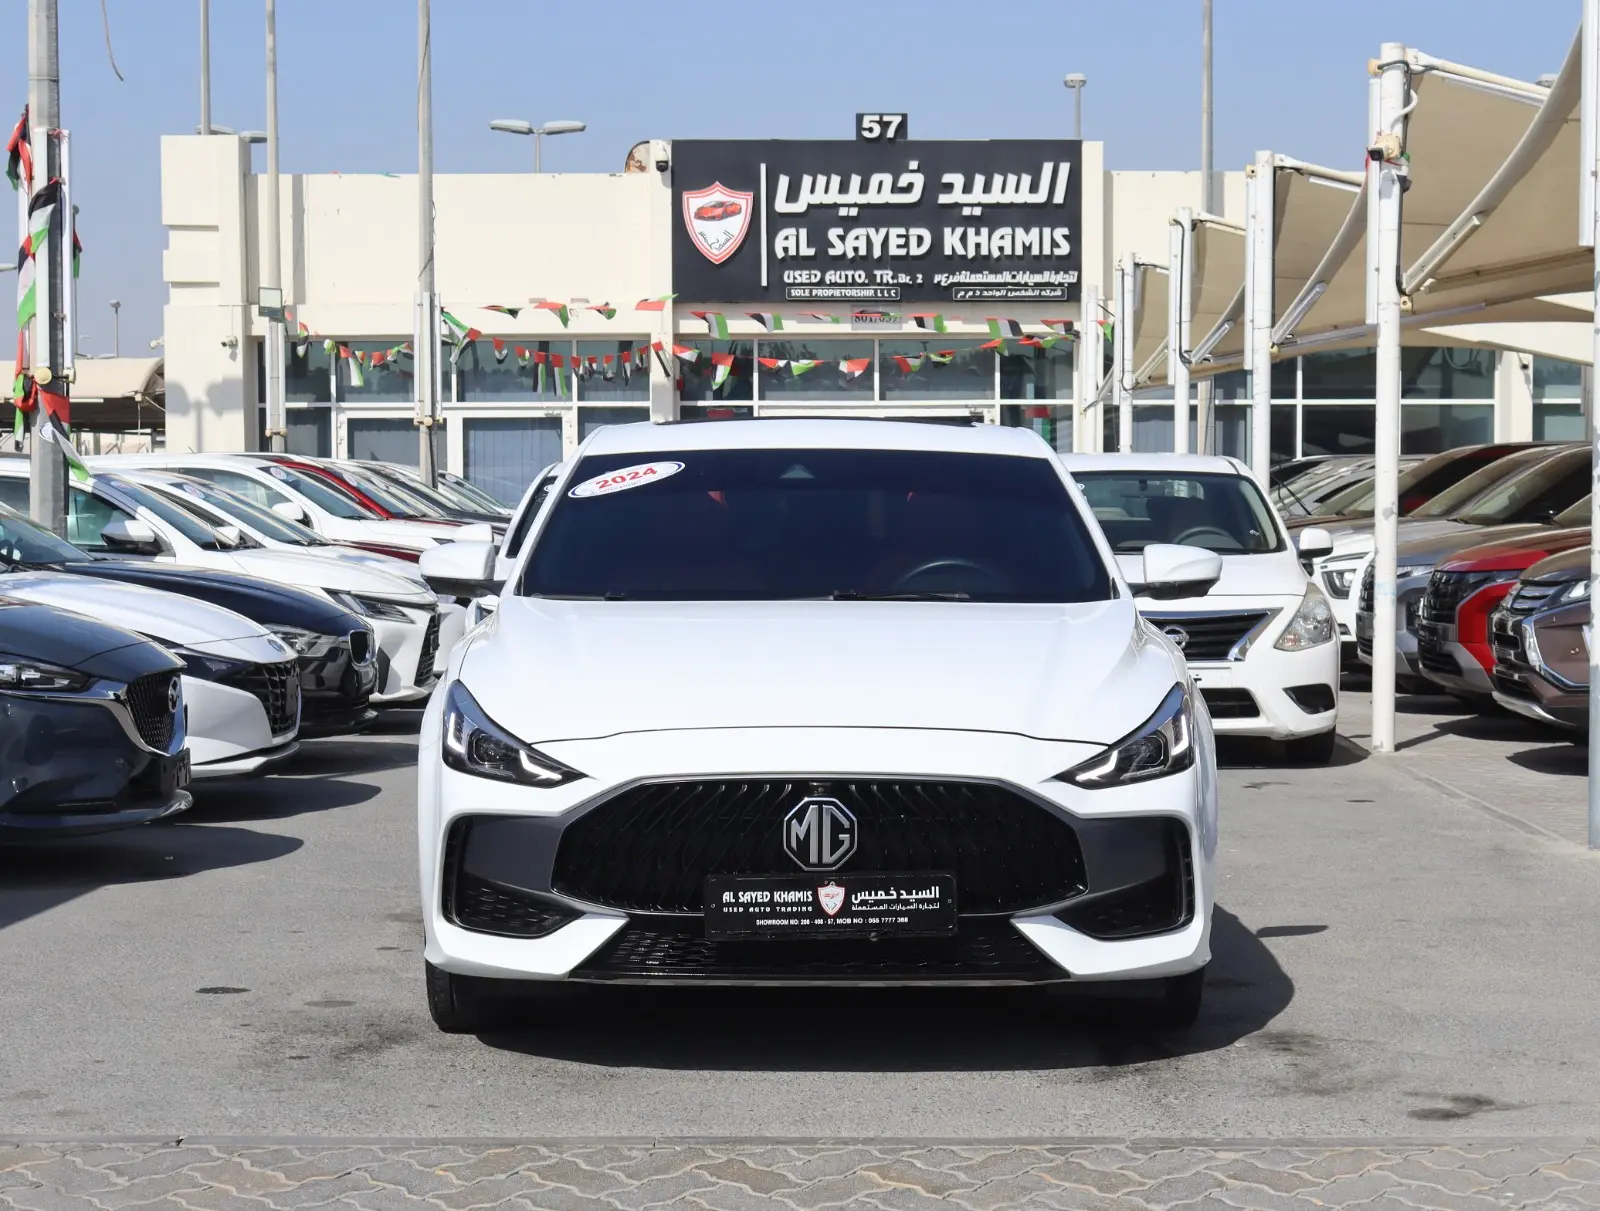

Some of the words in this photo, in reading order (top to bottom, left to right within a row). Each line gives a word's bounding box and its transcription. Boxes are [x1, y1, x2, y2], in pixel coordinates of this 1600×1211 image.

[860, 115, 903, 139] 57
[774, 160, 925, 216] خميس
[937, 162, 1071, 216] السيد
[774, 227, 816, 260] AL
[827, 227, 932, 260] SAYED
[943, 227, 1071, 260] KHAMIS
[783, 269, 821, 284] USED
[916, 273, 924, 284] 2
[790, 288, 810, 297] SOLE
[982, 288, 1006, 297] الواحد
[595, 467, 658, 489] 2024
[790, 804, 851, 865] MG
[722, 891, 736, 904] AL
[738, 891, 771, 904] SAYED
[773, 890, 813, 903] KHAMIS
[851, 886, 898, 904] خميس
[899, 885, 940, 902] السيد
[888, 902, 918, 911] السيارات
